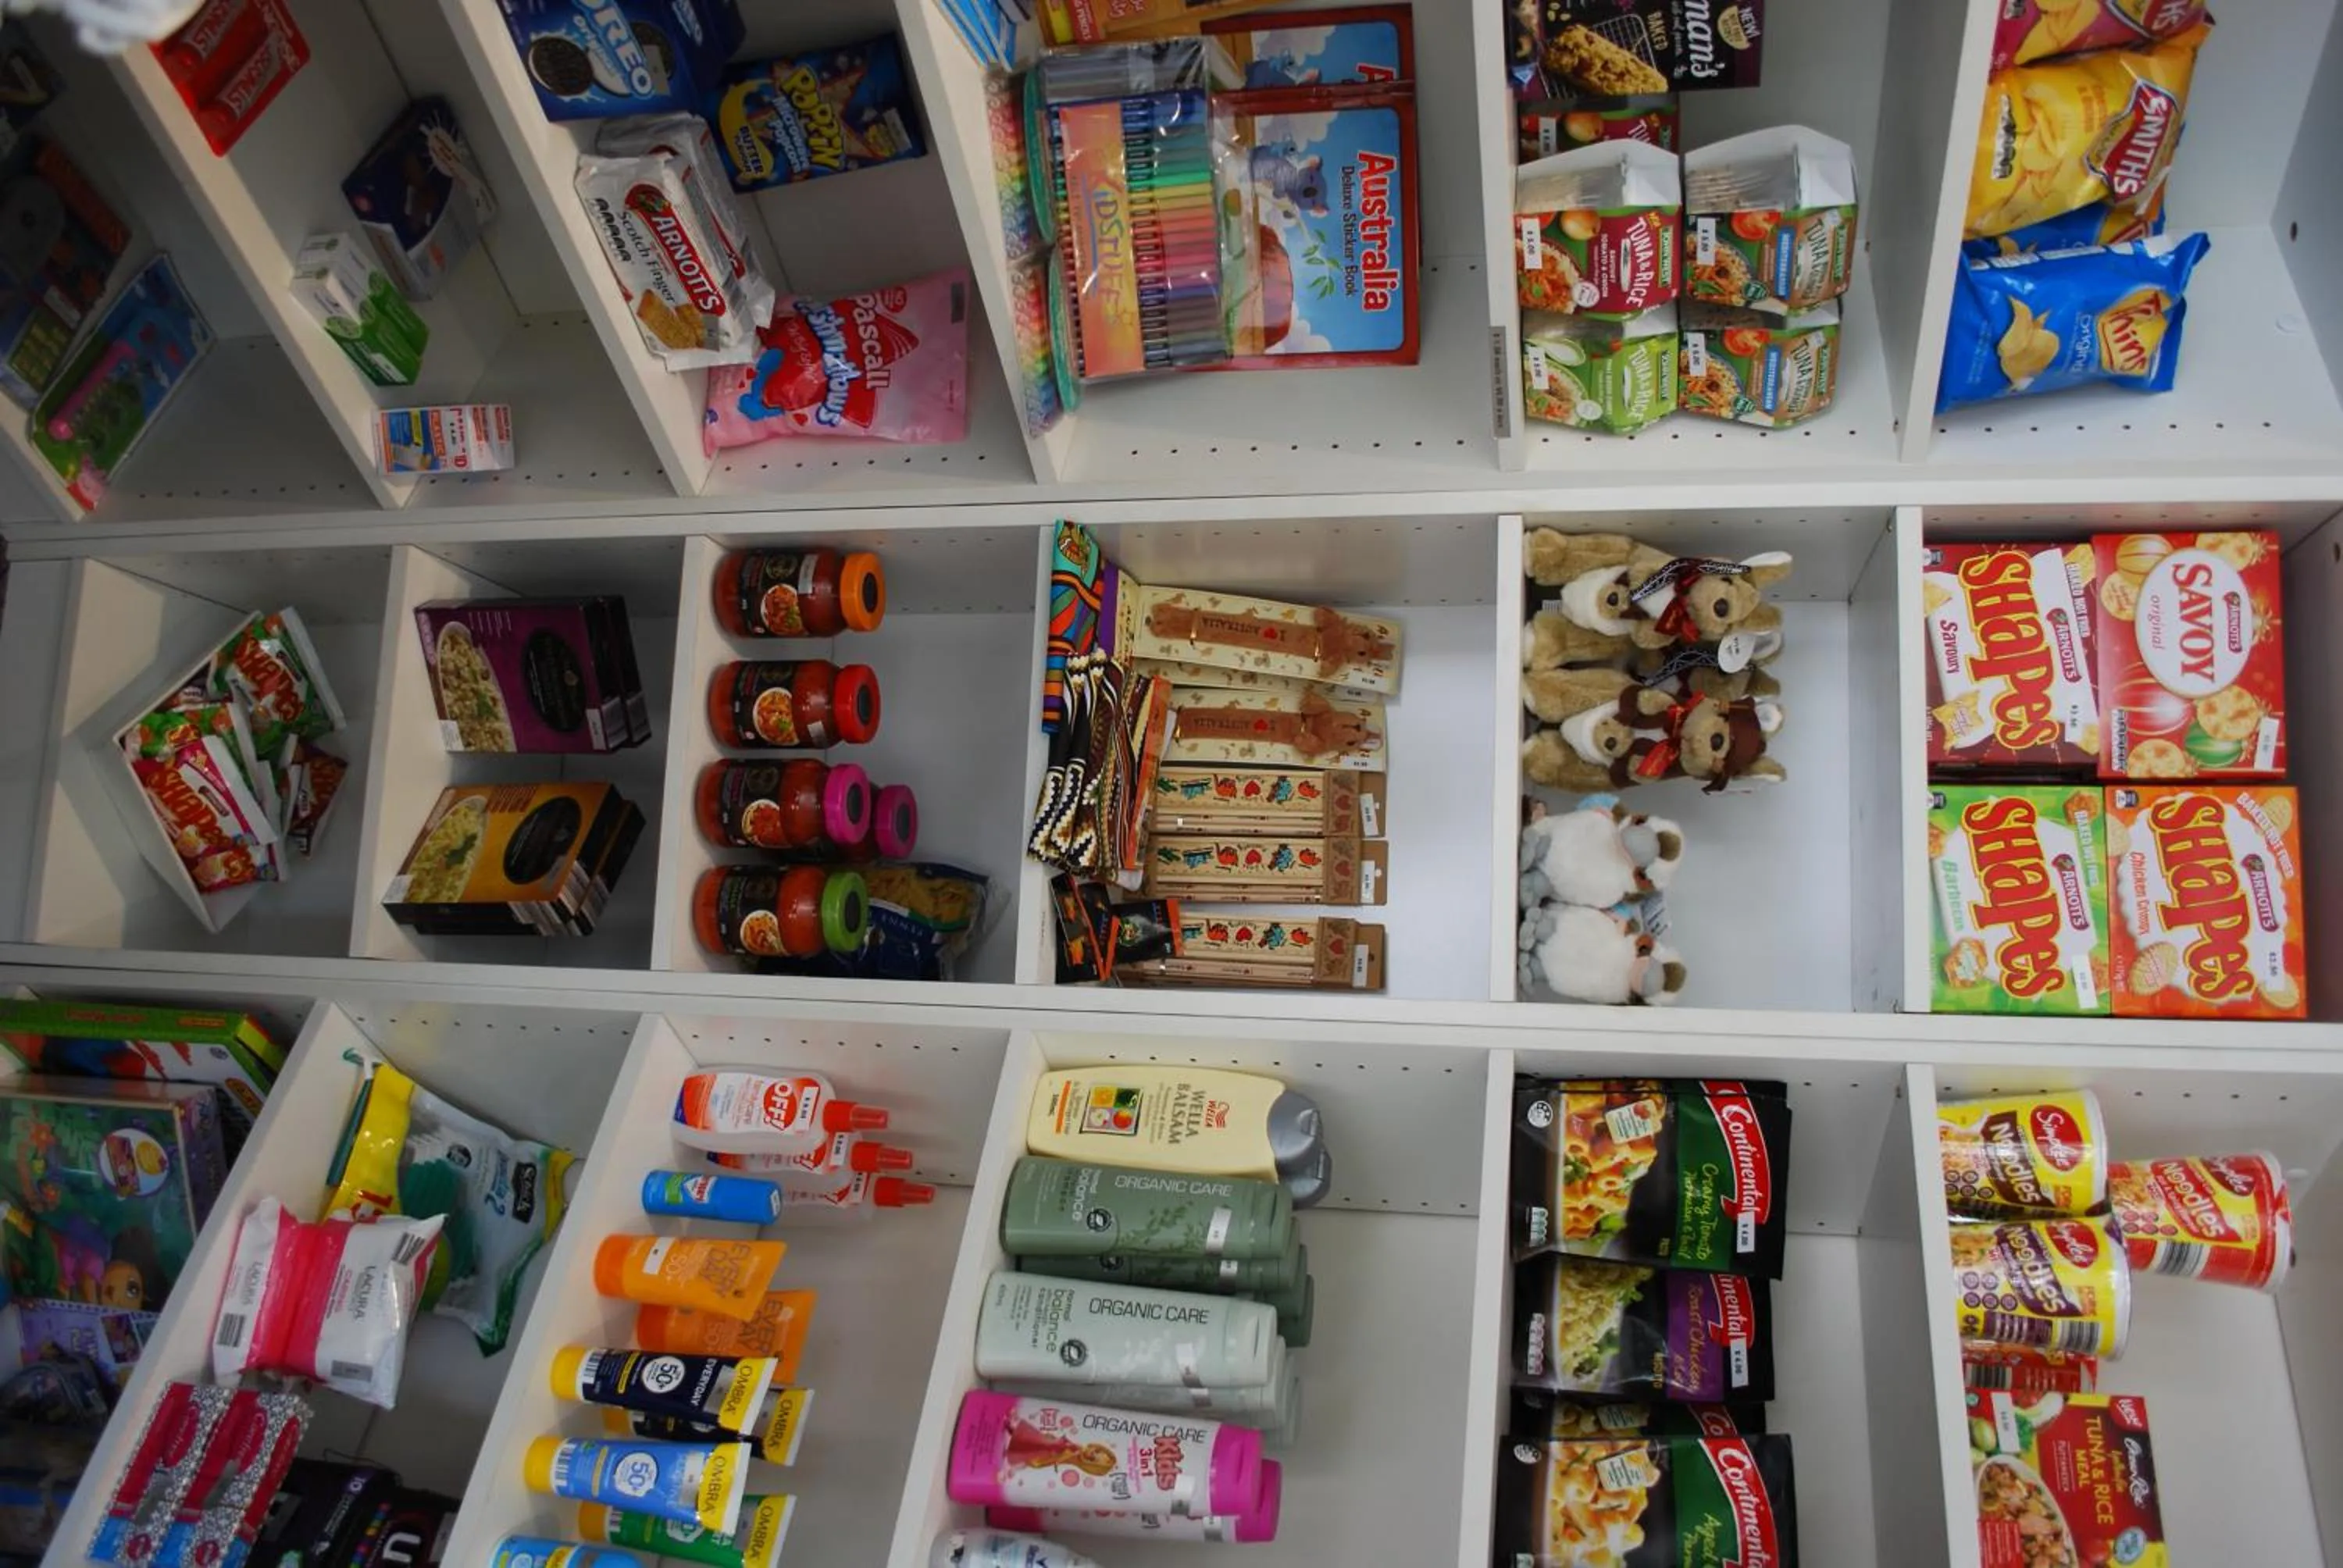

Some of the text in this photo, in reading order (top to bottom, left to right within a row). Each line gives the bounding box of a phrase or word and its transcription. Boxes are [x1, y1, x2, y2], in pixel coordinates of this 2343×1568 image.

[1646, 12, 1668, 51] BAKED
[1684, 0, 1725, 77] man's
[739, 125, 765, 174] BUTTER
[2111, 94, 2170, 194] SMITH'S
[615, 210, 677, 305] Scotch Finger
[1340, 166, 1359, 297] Deluxe Sticker Book
[1357, 151, 1400, 312] Australia
[1803, 219, 1828, 264] TUNA
[651, 216, 721, 312] ARNOTT'S
[797, 303, 861, 427] shmallows
[851, 294, 890, 390] Pascall
[1788, 340, 1813, 377] TUNA
[1939, 619, 1960, 675] Savoury
[2148, 595, 2165, 650] original
[2172, 563, 2215, 683] SAVOY
[2055, 624, 2077, 679] ARNOTT'S
[1941, 860, 1965, 932] Barbecue
[2061, 870, 2085, 927] ARNOTT'S
[2130, 851, 2149, 897] Chicken
[2251, 869, 2276, 928] ARNOTT'S
[763, 1082, 793, 1131] OFF!
[1167, 1083, 1191, 1145] BALSAM
[1184, 1090, 1206, 1139] WELLA
[1204, 1099, 1218, 1129] WELLA
[1114, 1174, 1186, 1194] ORGANIC
[1189, 1182, 1235, 1198] CARE
[1721, 1103, 1767, 1213] Continental
[1693, 1163, 1719, 1261] Creamy Tomato
[2161, 1162, 2224, 1238] Noodles
[242, 1261, 263, 1306] LACURA
[353, 1265, 376, 1320] LACURA
[2003, 1225, 2067, 1313] Noodles
[751, 1299, 784, 1354] EVER
[1045, 1288, 1066, 1354] balance
[1089, 1297, 1210, 1325] ORGANIC CARE
[1718, 1274, 1749, 1338] tinental
[690, 1357, 716, 1407] EVERYDAY
[1685, 1327, 1708, 1393] Chicken
[724, 1364, 754, 1415] OMBRA
[767, 1399, 794, 1449] OMBRA
[1082, 1414, 1208, 1444] ORGANIC CARE
[703, 1455, 728, 1516] OMBRA
[1153, 1434, 1183, 1491] Kids
[2075, 1449, 2090, 1488] MEAL
[2084, 1415, 2114, 1525] TUNA & RICE
[750, 1506, 774, 1561] OMBRA
[1717, 1448, 1773, 1568] Continenta
[1694, 1512, 1724, 1563] Aged
